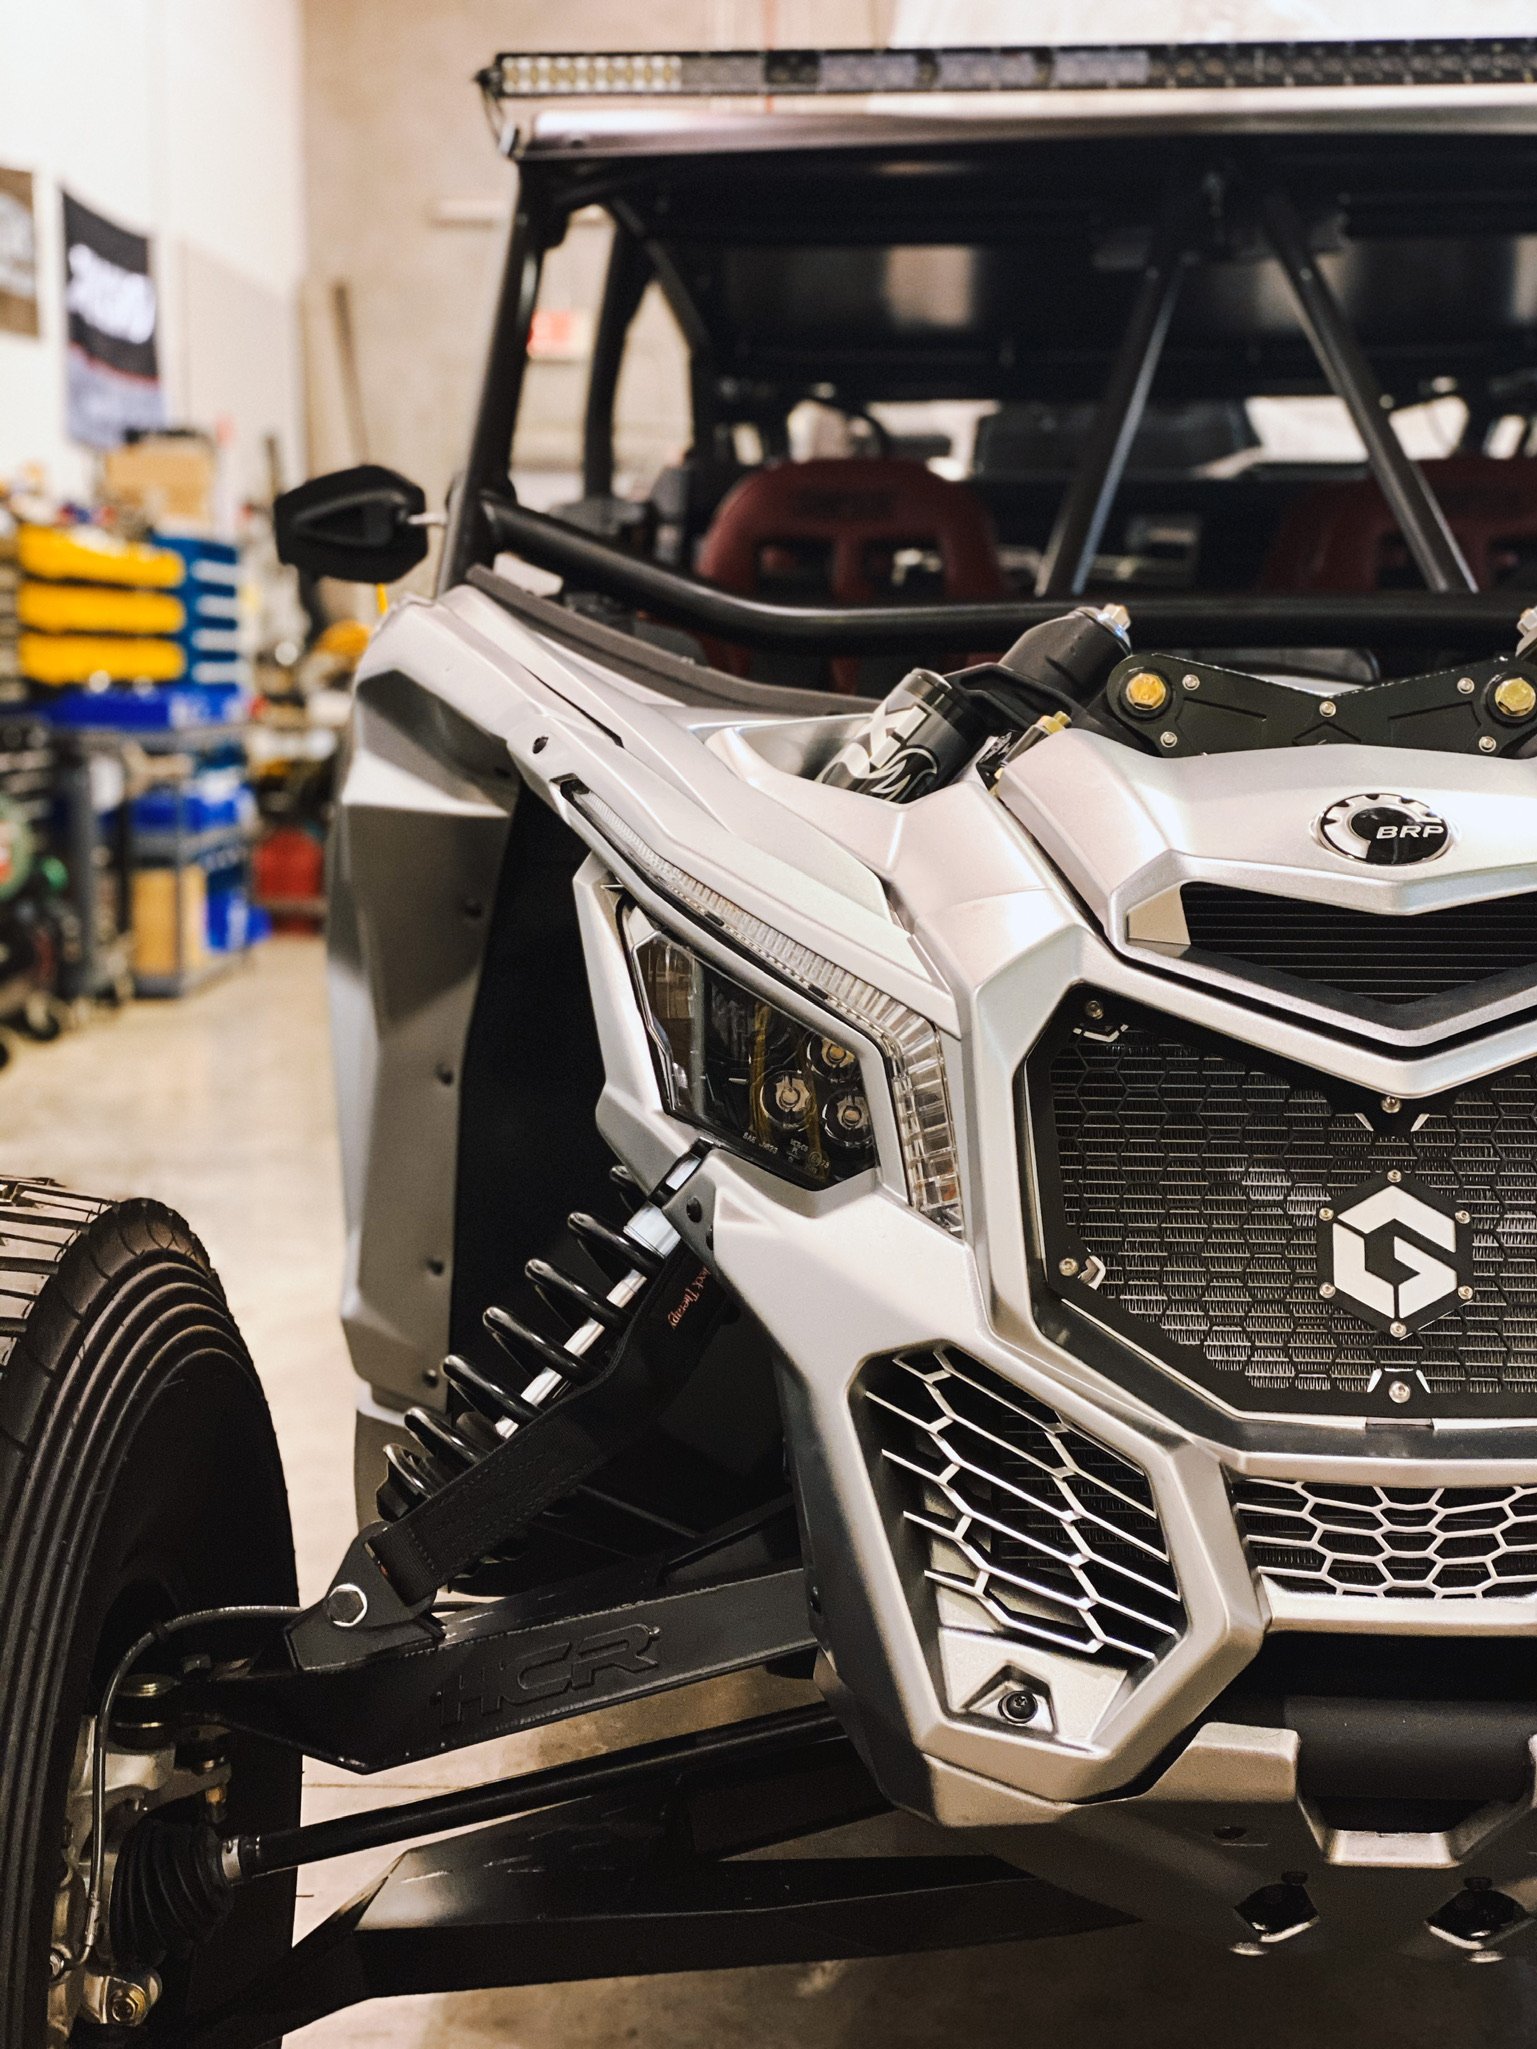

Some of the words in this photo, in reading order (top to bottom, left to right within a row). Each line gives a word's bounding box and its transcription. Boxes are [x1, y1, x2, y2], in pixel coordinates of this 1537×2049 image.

[1376, 825, 1444, 839] BRP
[691, 1266, 711, 1290] hock
[667, 1287, 700, 1330] Therapy
[431, 1622, 659, 1728] HCR
